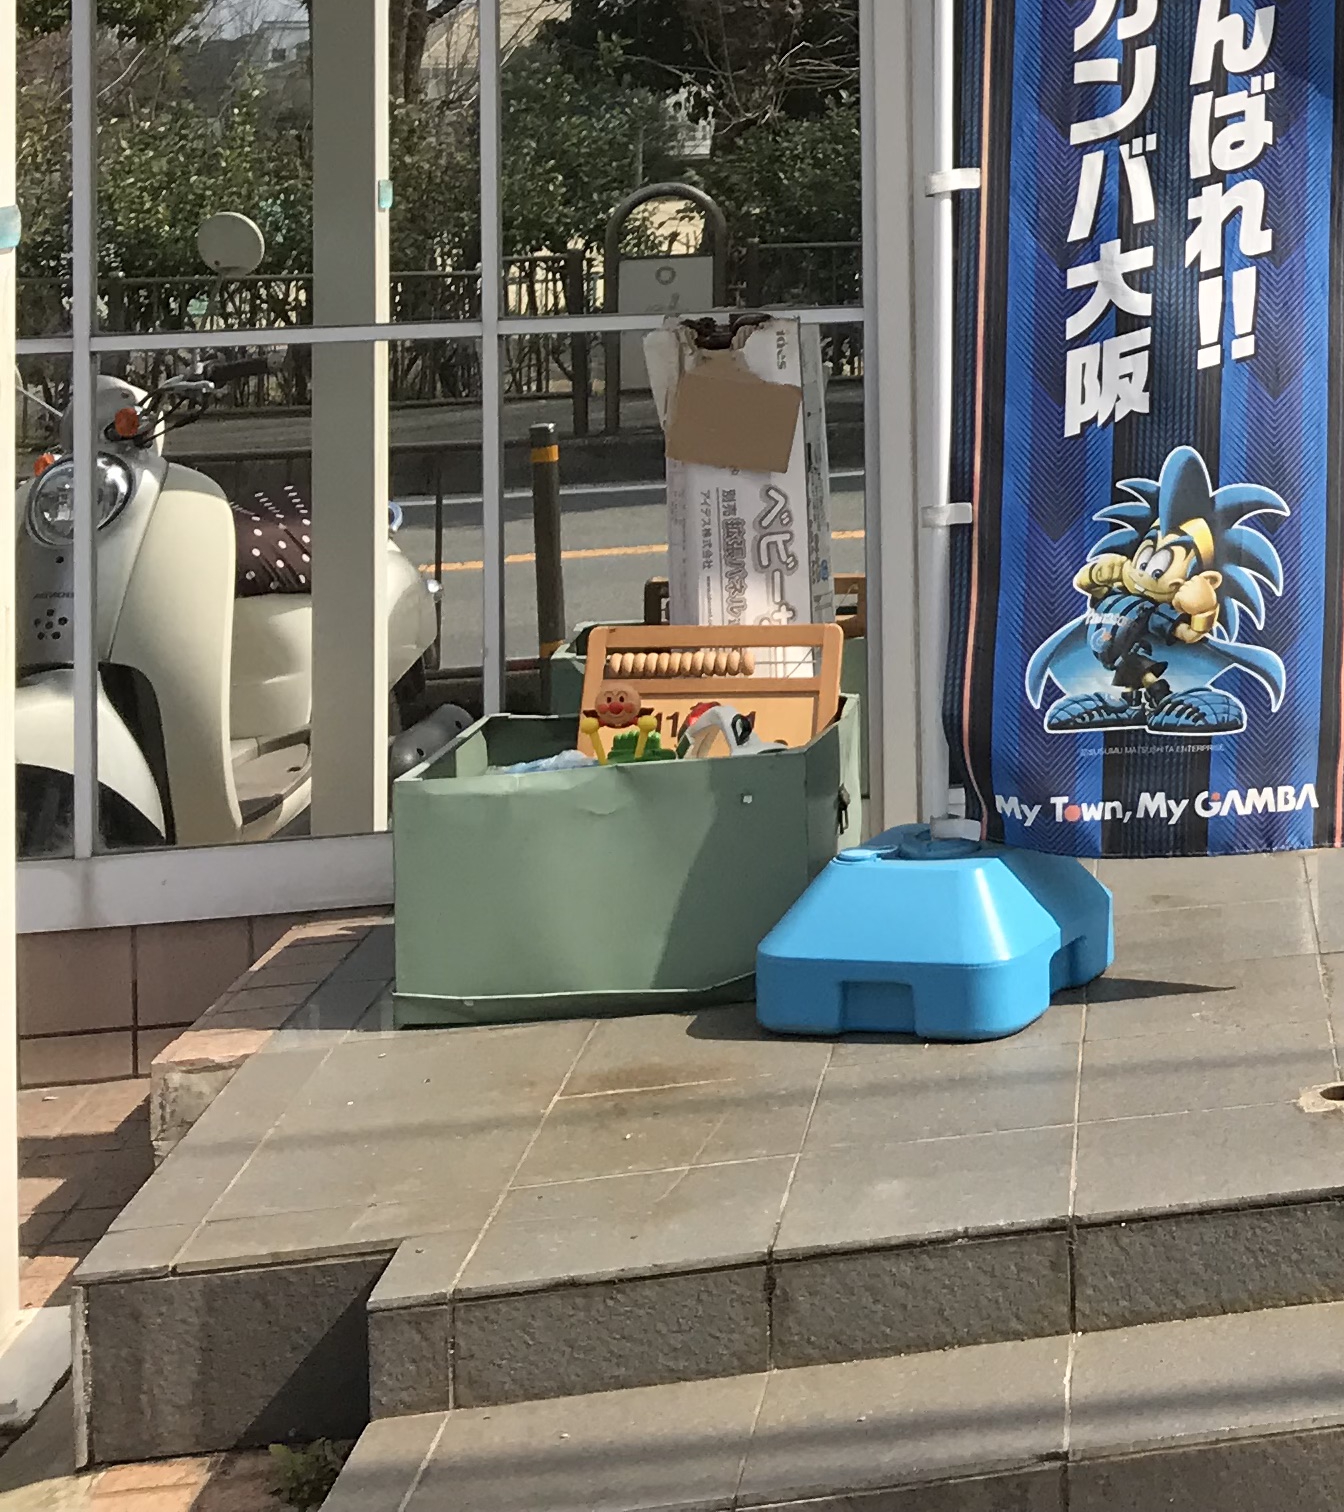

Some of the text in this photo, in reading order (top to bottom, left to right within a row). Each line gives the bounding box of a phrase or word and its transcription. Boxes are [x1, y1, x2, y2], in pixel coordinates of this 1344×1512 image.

[995, 793, 1041, 827] My
[1137, 791, 1189, 825] My
[1194, 782, 1320, 818] GAMBA
